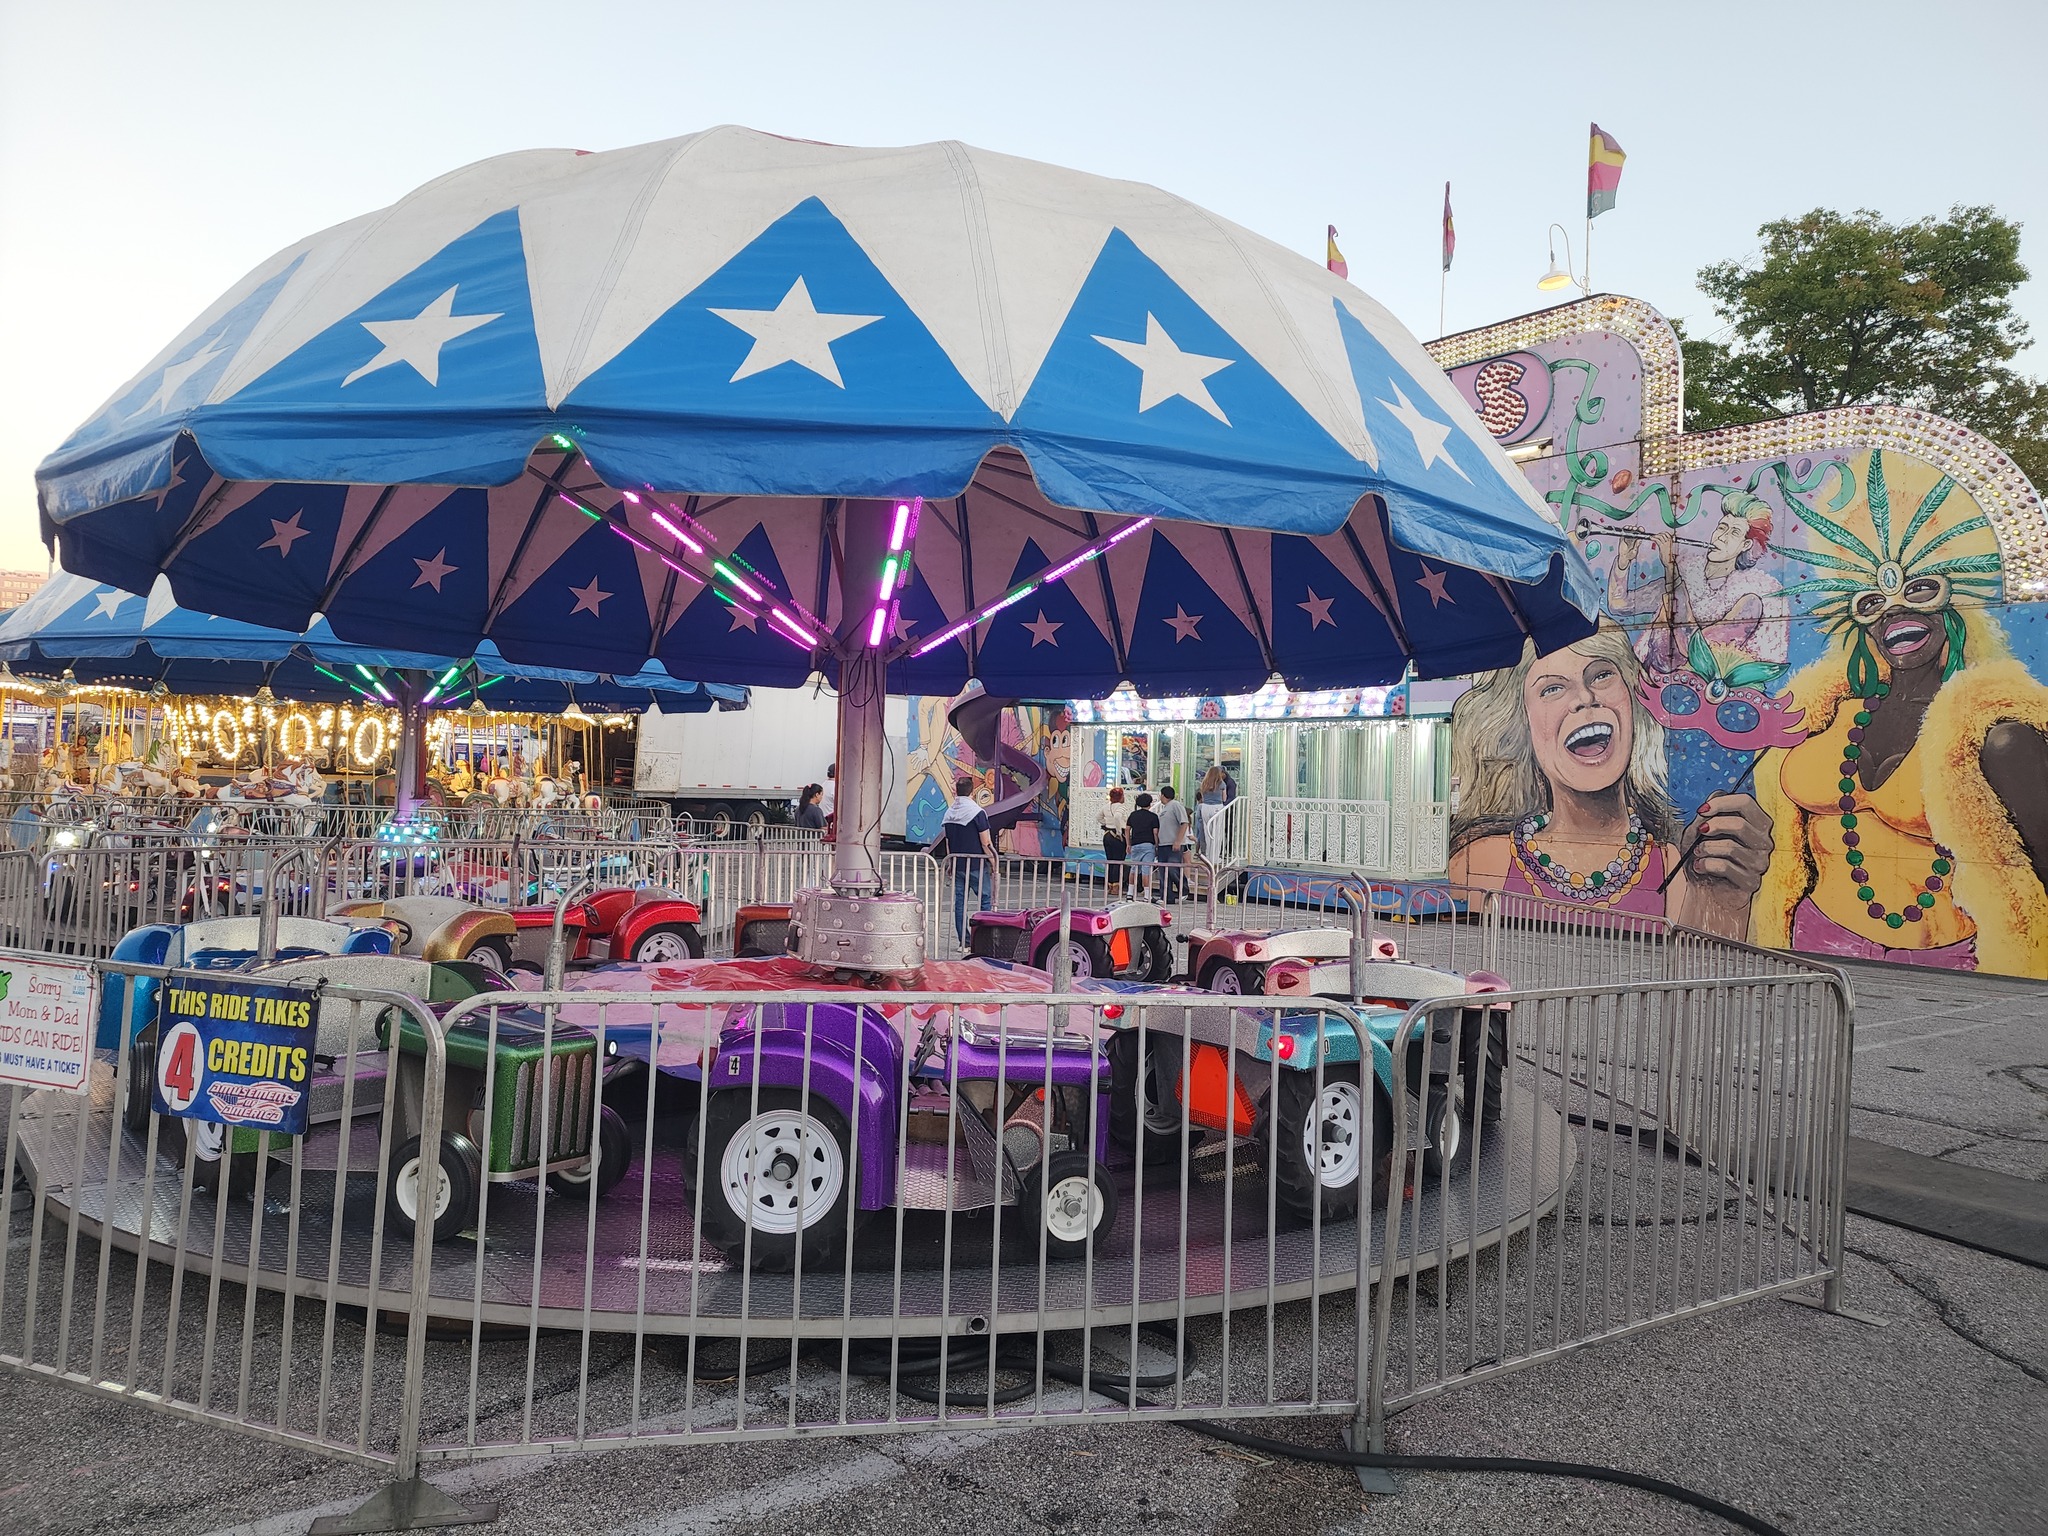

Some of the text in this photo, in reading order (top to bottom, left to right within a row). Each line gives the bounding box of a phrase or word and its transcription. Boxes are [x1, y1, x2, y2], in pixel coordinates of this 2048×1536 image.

[29, 976, 62, 1001] Sorry
[8, 1000, 79, 1026] Mom & Dad
[169, 989, 311, 1029] THIS RIDE TAKES
[24, 1029, 49, 1048] CAN
[52, 1032, 84, 1053] RIDE!
[3, 1052, 81, 1076] MUST HAVE A TICKET
[164, 1032, 308, 1101] 4 CREDITS
[731, 1056, 739, 1074] 4
